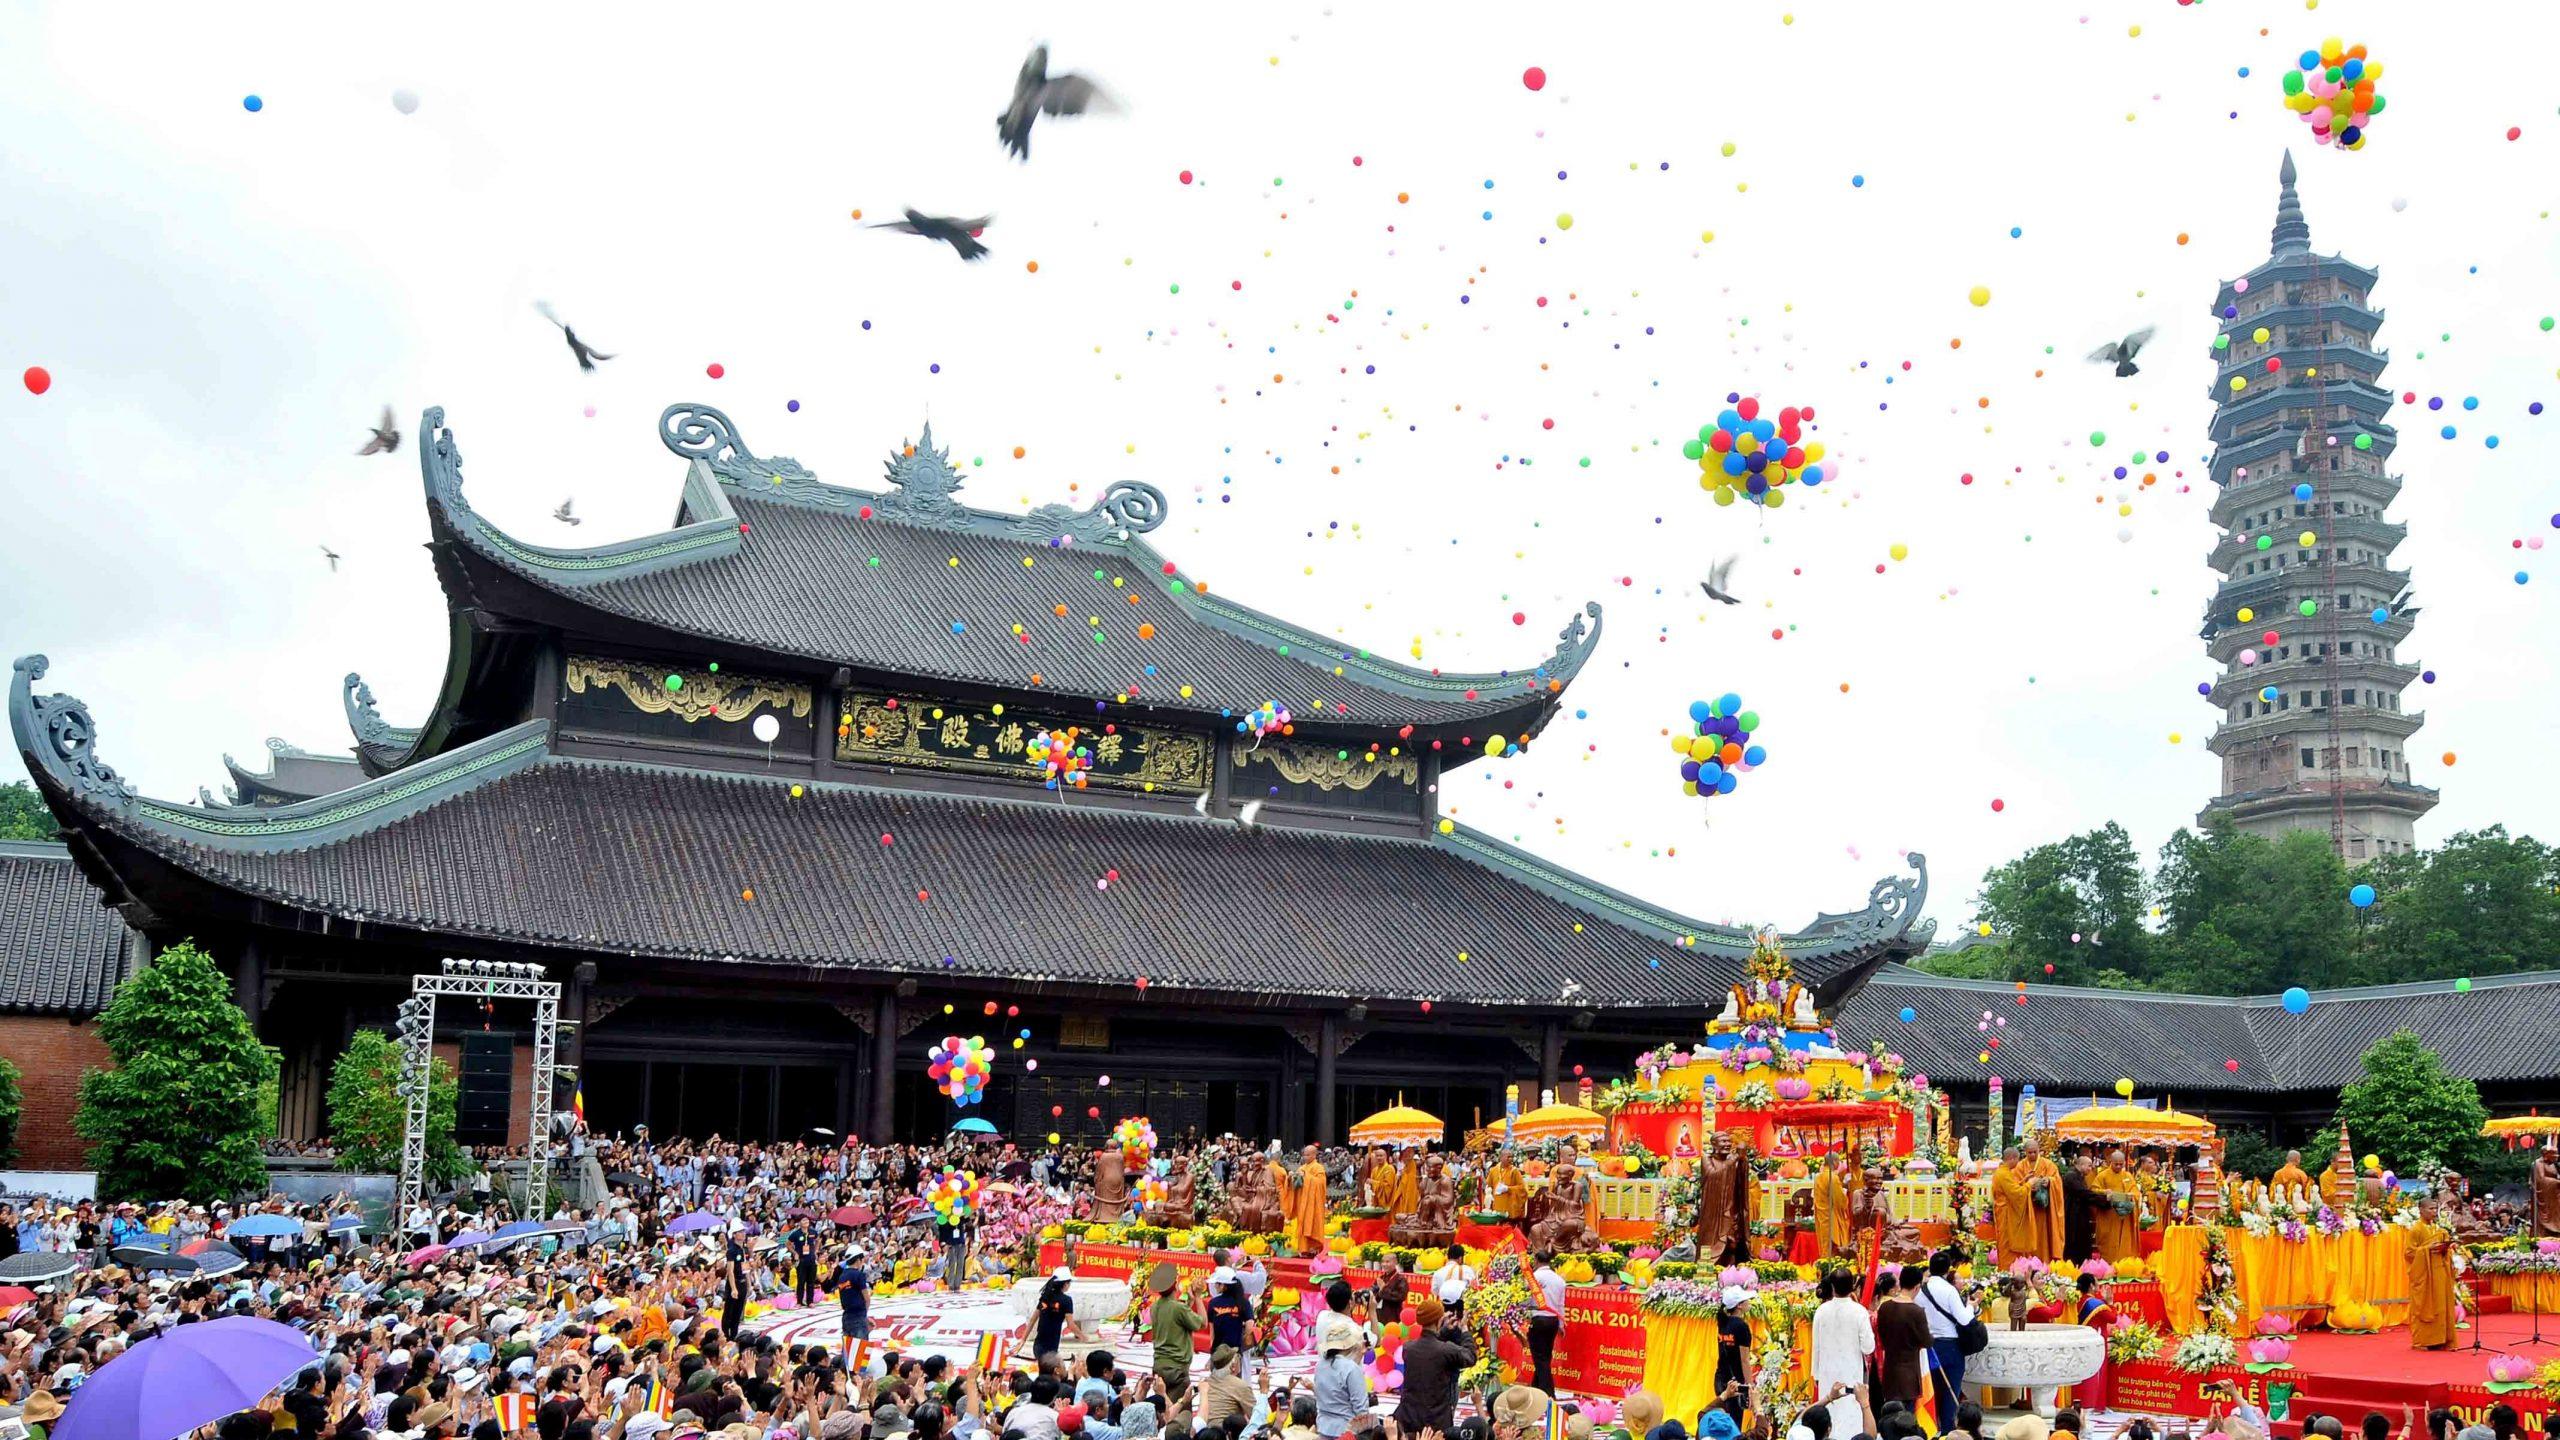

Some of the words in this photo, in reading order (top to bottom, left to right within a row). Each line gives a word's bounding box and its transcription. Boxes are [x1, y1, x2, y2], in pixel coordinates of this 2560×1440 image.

[1086, 1255, 1109, 1267] VESAK
[1110, 1257, 1127, 1269] LIÊN
[1190, 1267, 1211, 1278] 2014
[2113, 1300, 2140, 1314] 014
[1564, 1307, 1604, 1326] ESAK
[1608, 1312, 1648, 1329] 2014
[1600, 1344, 1638, 1358] Sustainable
[1558, 1366, 1581, 1381] Society
[1599, 1359, 1642, 1375] Development
[1599, 1374, 1627, 1387] Civilized
